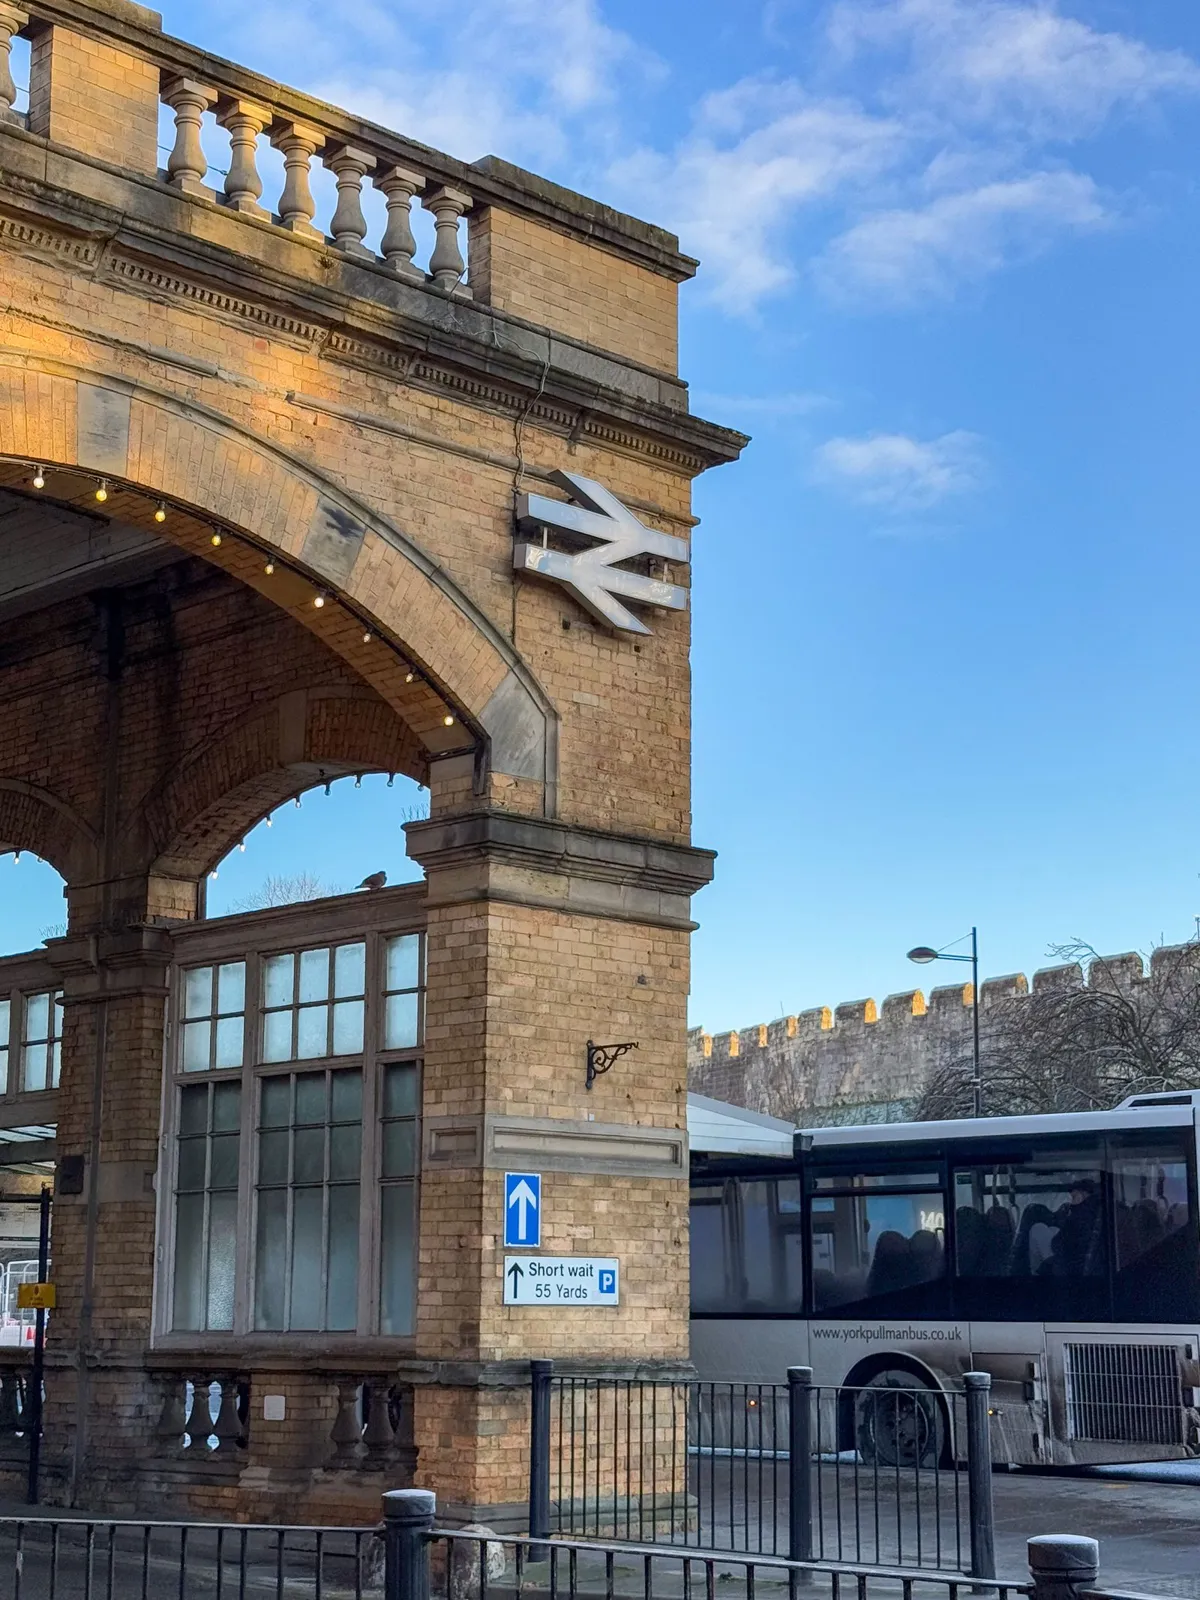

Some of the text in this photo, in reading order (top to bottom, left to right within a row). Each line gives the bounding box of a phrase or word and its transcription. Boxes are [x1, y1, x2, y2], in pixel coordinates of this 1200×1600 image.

[528, 1262, 594, 1277] Short wait
[603, 1273, 613, 1291] P
[535, 1284, 588, 1298] 55 Yards
[813, 1326, 962, 1343] www.yorkpullmanbus.co.uk
